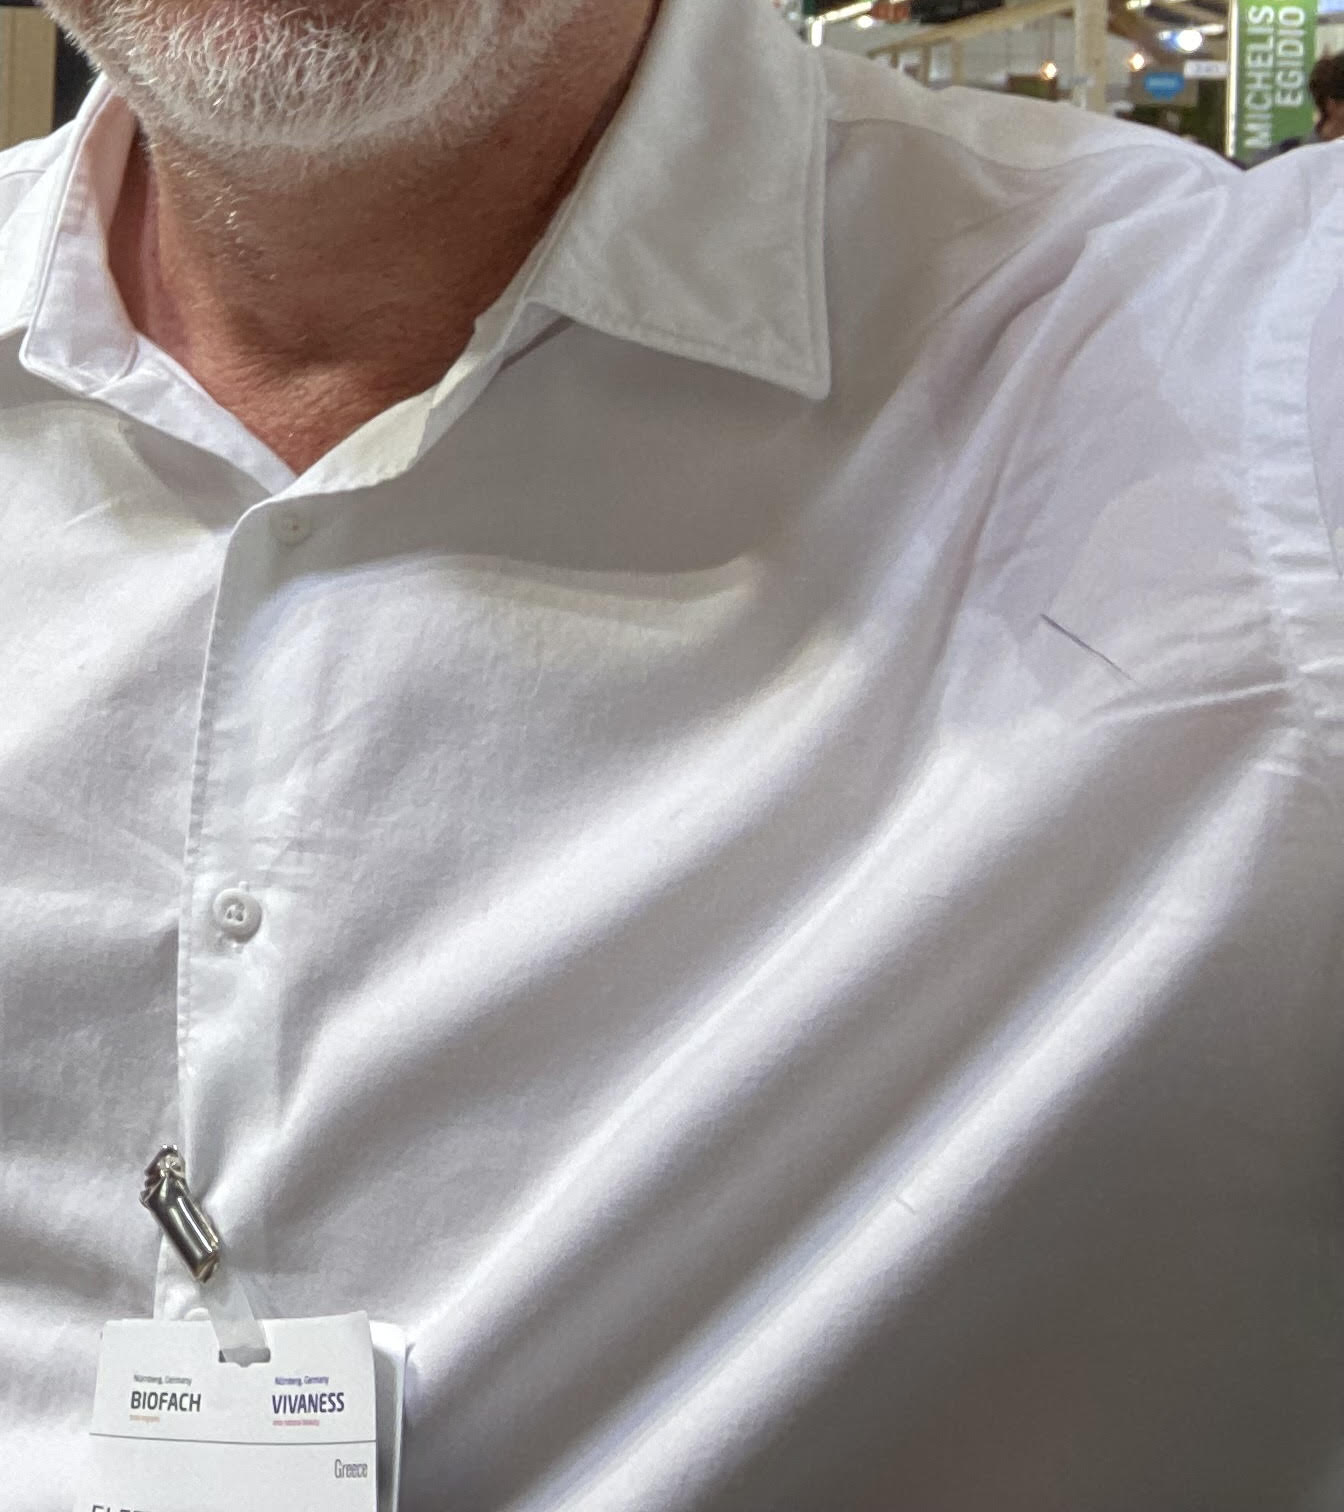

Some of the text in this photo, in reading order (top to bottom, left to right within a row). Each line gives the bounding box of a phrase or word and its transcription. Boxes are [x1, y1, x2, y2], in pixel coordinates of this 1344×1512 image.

[1275, 5, 1306, 108] EGIDIO
[1243, 4, 1275, 150] MICHELIS
[130, 1390, 202, 1413] BIOFACH
[271, 1391, 345, 1415] VIVANESS
[334, 1458, 368, 1479] Greece
